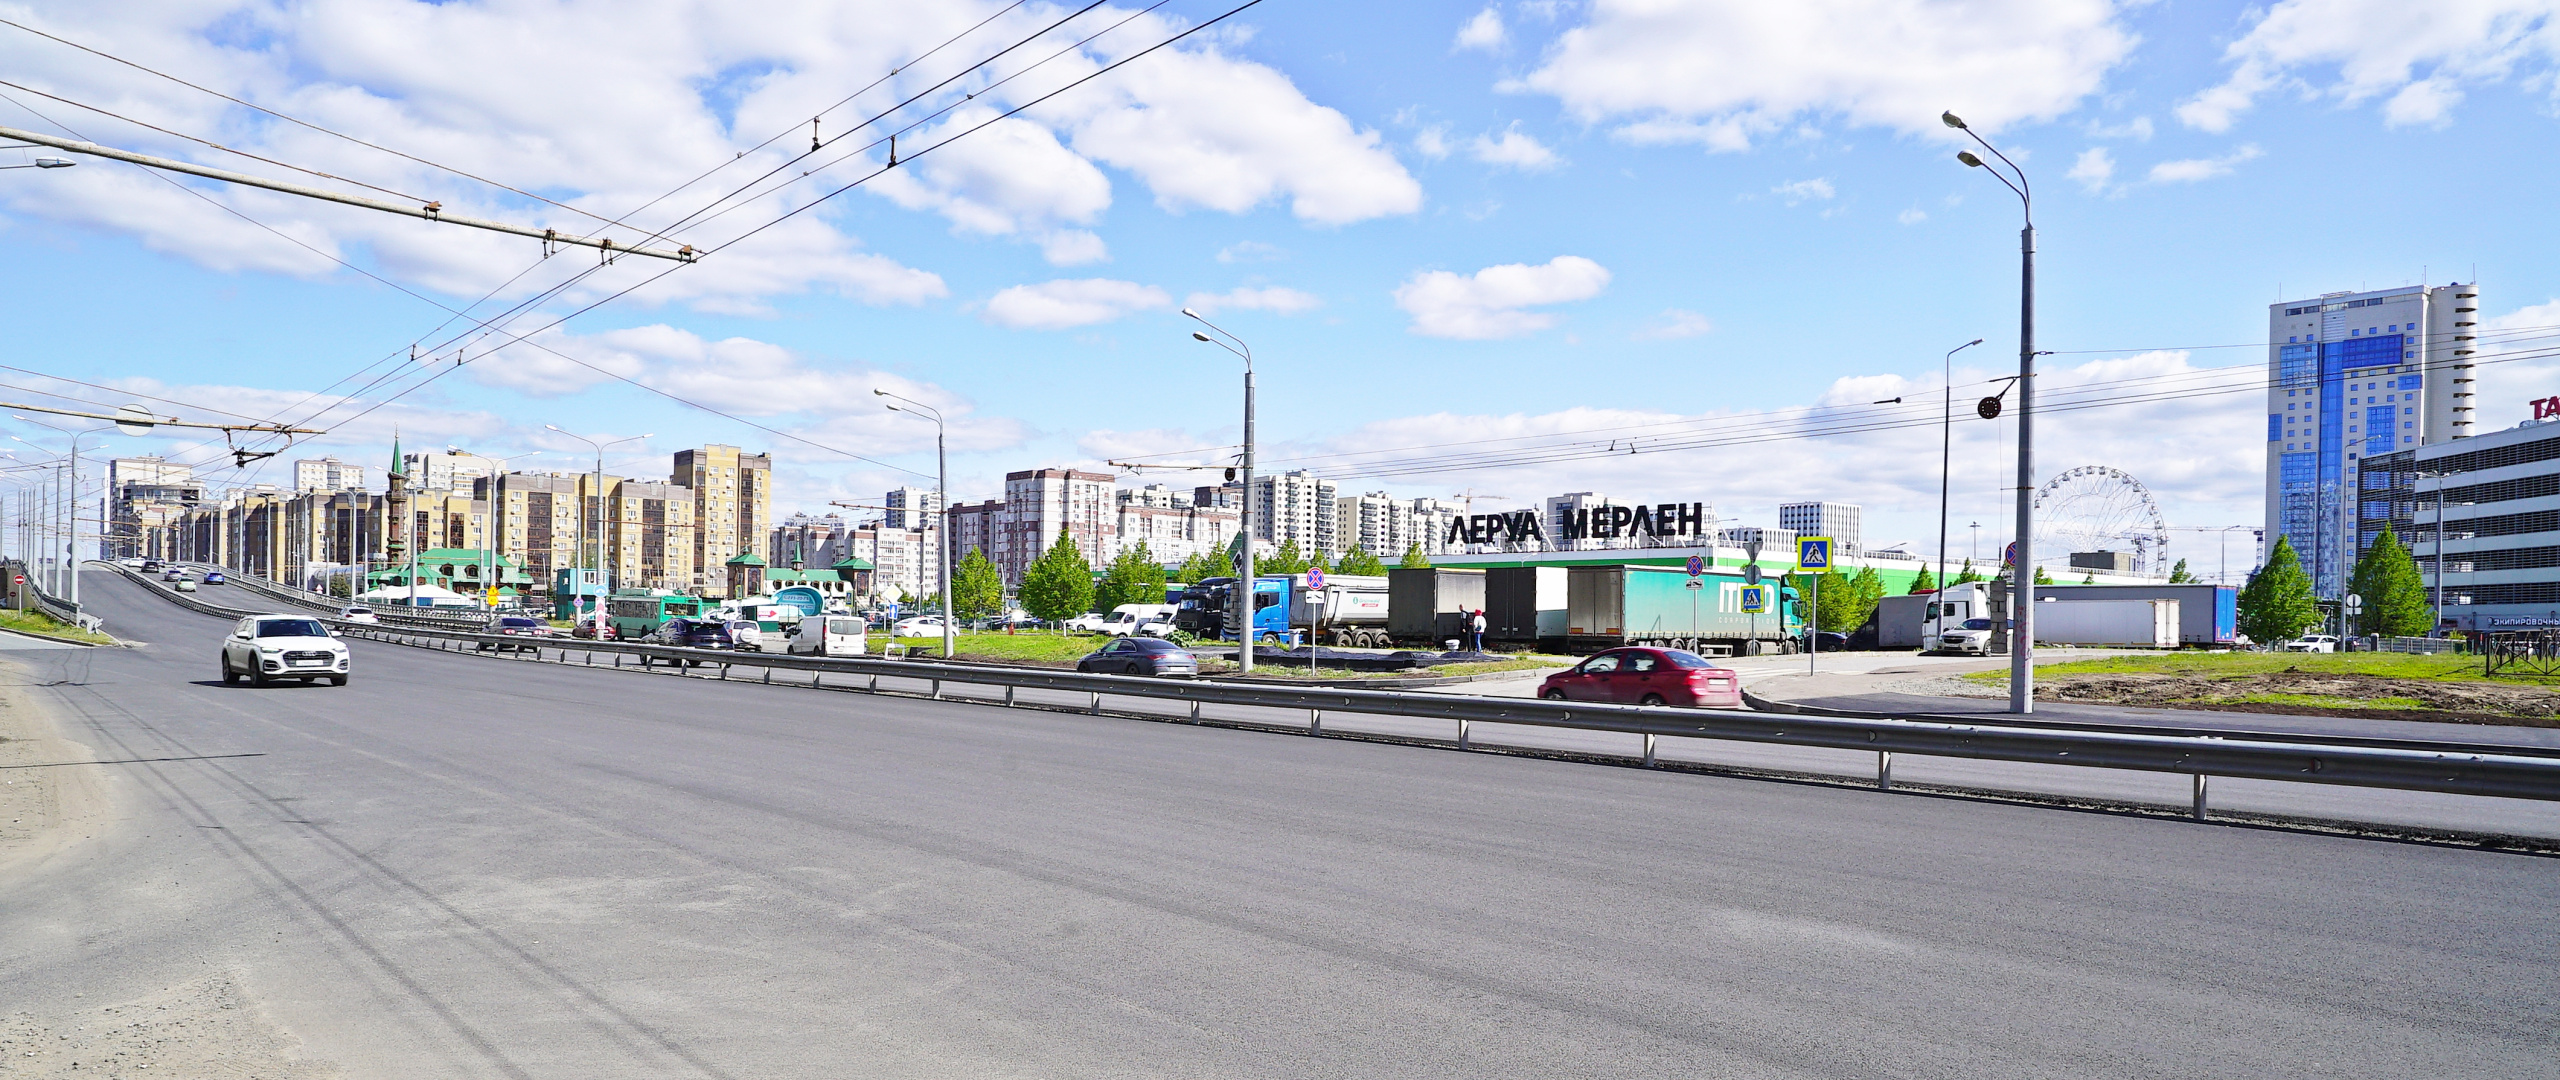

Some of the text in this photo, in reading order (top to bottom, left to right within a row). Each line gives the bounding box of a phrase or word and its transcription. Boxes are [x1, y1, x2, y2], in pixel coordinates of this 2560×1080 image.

[1447, 502, 1702, 544] ЛЕРУА МЕРЛЕН
[1719, 582, 1775, 614] ITO
[1719, 616, 1775, 624] CORPORTION
